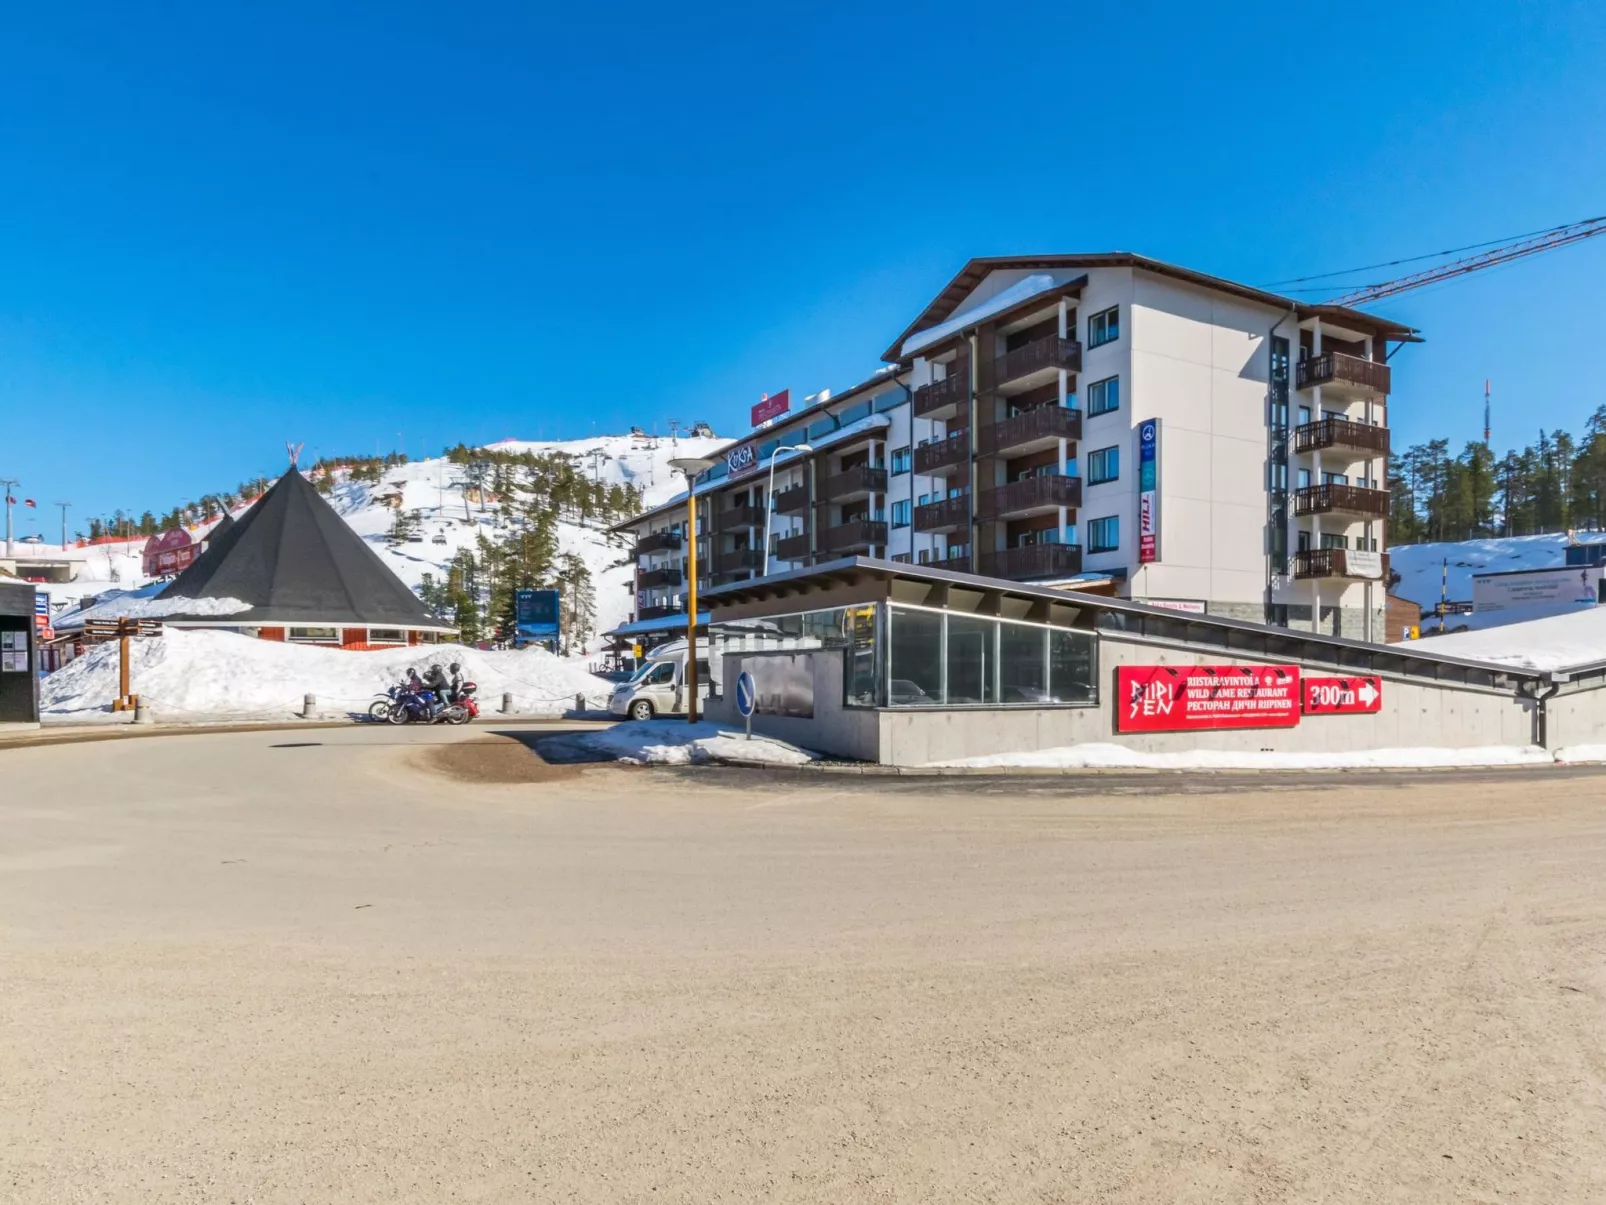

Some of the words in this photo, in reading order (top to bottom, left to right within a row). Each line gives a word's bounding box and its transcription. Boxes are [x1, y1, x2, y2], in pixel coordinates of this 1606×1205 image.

[1187, 675, 1260, 687] RIISTARAVINTOLA
[1187, 688, 1210, 698] WILD
[1211, 687, 1241, 698] GAME
[1242, 687, 1288, 698] RESTAURANT
[1310, 685, 1355, 706] 300m
[1130, 699, 1174, 719] SEN
[1187, 701, 1230, 711] РЕСТОРАН
[1231, 700, 1256, 711] ДИЧИ
[1258, 699, 1292, 709] RIIPINEN
